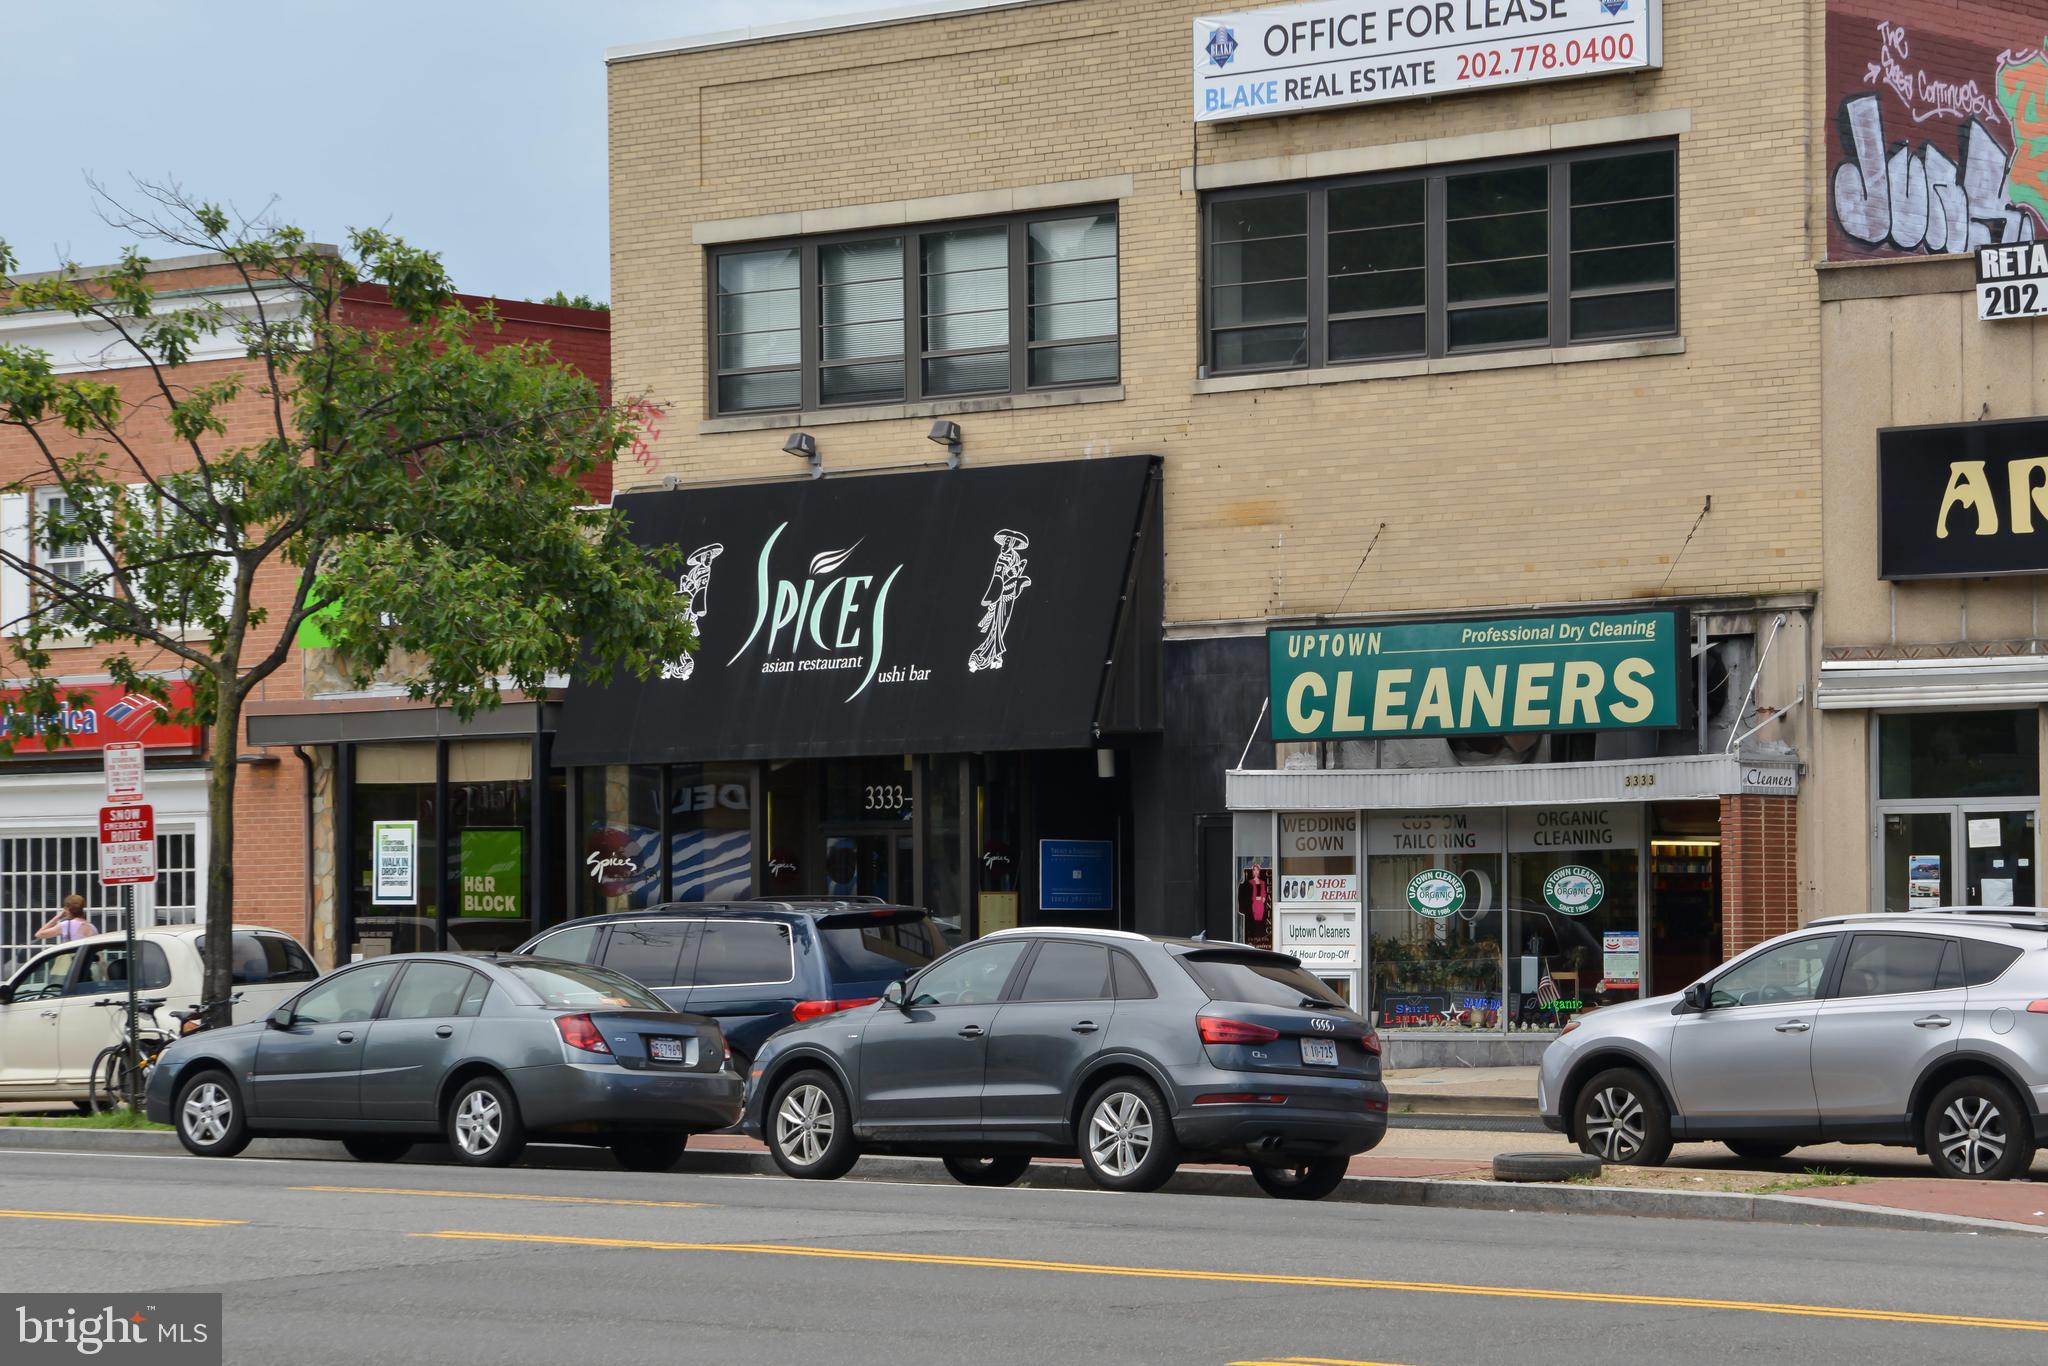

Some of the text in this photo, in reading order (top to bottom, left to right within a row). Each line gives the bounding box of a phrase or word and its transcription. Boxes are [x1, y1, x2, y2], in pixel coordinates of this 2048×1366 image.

[1263, 0, 1568, 57] OFFICE FOR LEASE
[1204, 33, 1634, 113] BLAKE REAL ESTATE 202.778.0400
[1985, 284, 2048, 317] 202.
[1287, 620, 1657, 658] UPTOWN Professional Dry Cleaning
[761, 656, 863, 673] asian restaurant
[909, 664, 931, 681] bar
[1285, 657, 1657, 735] CLEANERS
[1625, 774, 1655, 787] 3333
[1746, 769, 1793, 787] Cleaners
[109, 809, 140, 821] SNOW
[1537, 810, 1609, 826] ORGANIC
[103, 821, 148, 831] EMERGENCY
[1282, 816, 1356, 833] WEDDING
[111, 831, 142, 842] ROUTE
[1295, 836, 1344, 851] GOWN
[1393, 833, 1476, 849] TAILORING
[1533, 829, 1613, 846] CLEANING
[106, 843, 149, 854] NO PARKING
[111, 855, 142, 865] DURING
[381, 857, 400, 867] WALK
[105, 867, 150, 877] EMERGENCY
[381, 867, 408, 876] DROP OFF
[464, 876, 496, 892] H&R
[1316, 879, 1347, 889] SHOE
[1409, 871, 1463, 899] UPTOWN CLEANERS
[1546, 867, 1601, 896] UPTOWN CLEANERS
[1321, 891, 1358, 901] REPAIR
[1420, 891, 1453, 899] ORGANIC
[1557, 888, 1591, 896] ORGANIC
[464, 895, 516, 912] BLOCK
[1289, 925, 1351, 941] Uptown Cleaners
[1300, 950, 1316, 959] Hour
[1318, 950, 1350, 959] Drop-Off
